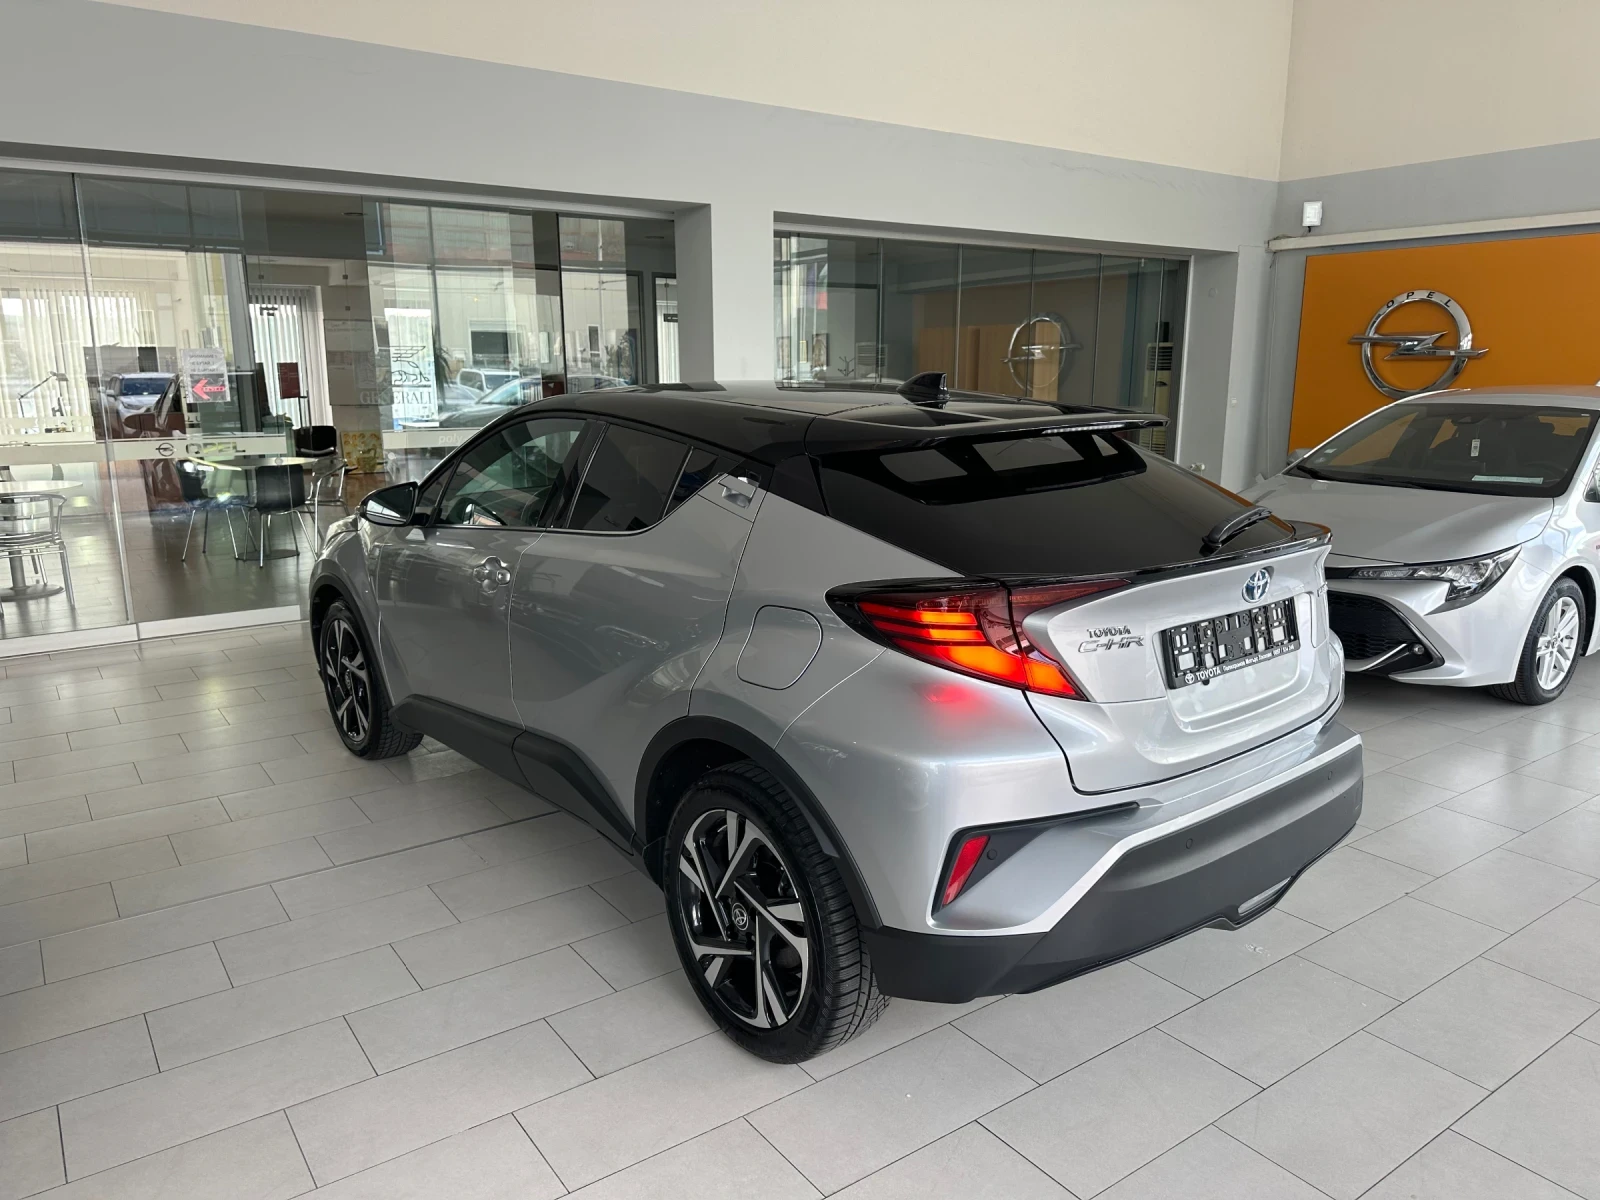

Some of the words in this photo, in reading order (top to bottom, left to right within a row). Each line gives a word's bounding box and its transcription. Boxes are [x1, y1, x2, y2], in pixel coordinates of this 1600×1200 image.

[1386, 291, 1452, 309] OPEL
[361, 391, 433, 405] GENERALI
[1087, 625, 1131, 638] TOYOTA
[1078, 636, 1144, 653] C-HR
[1196, 666, 1221, 681] TOYOTA
